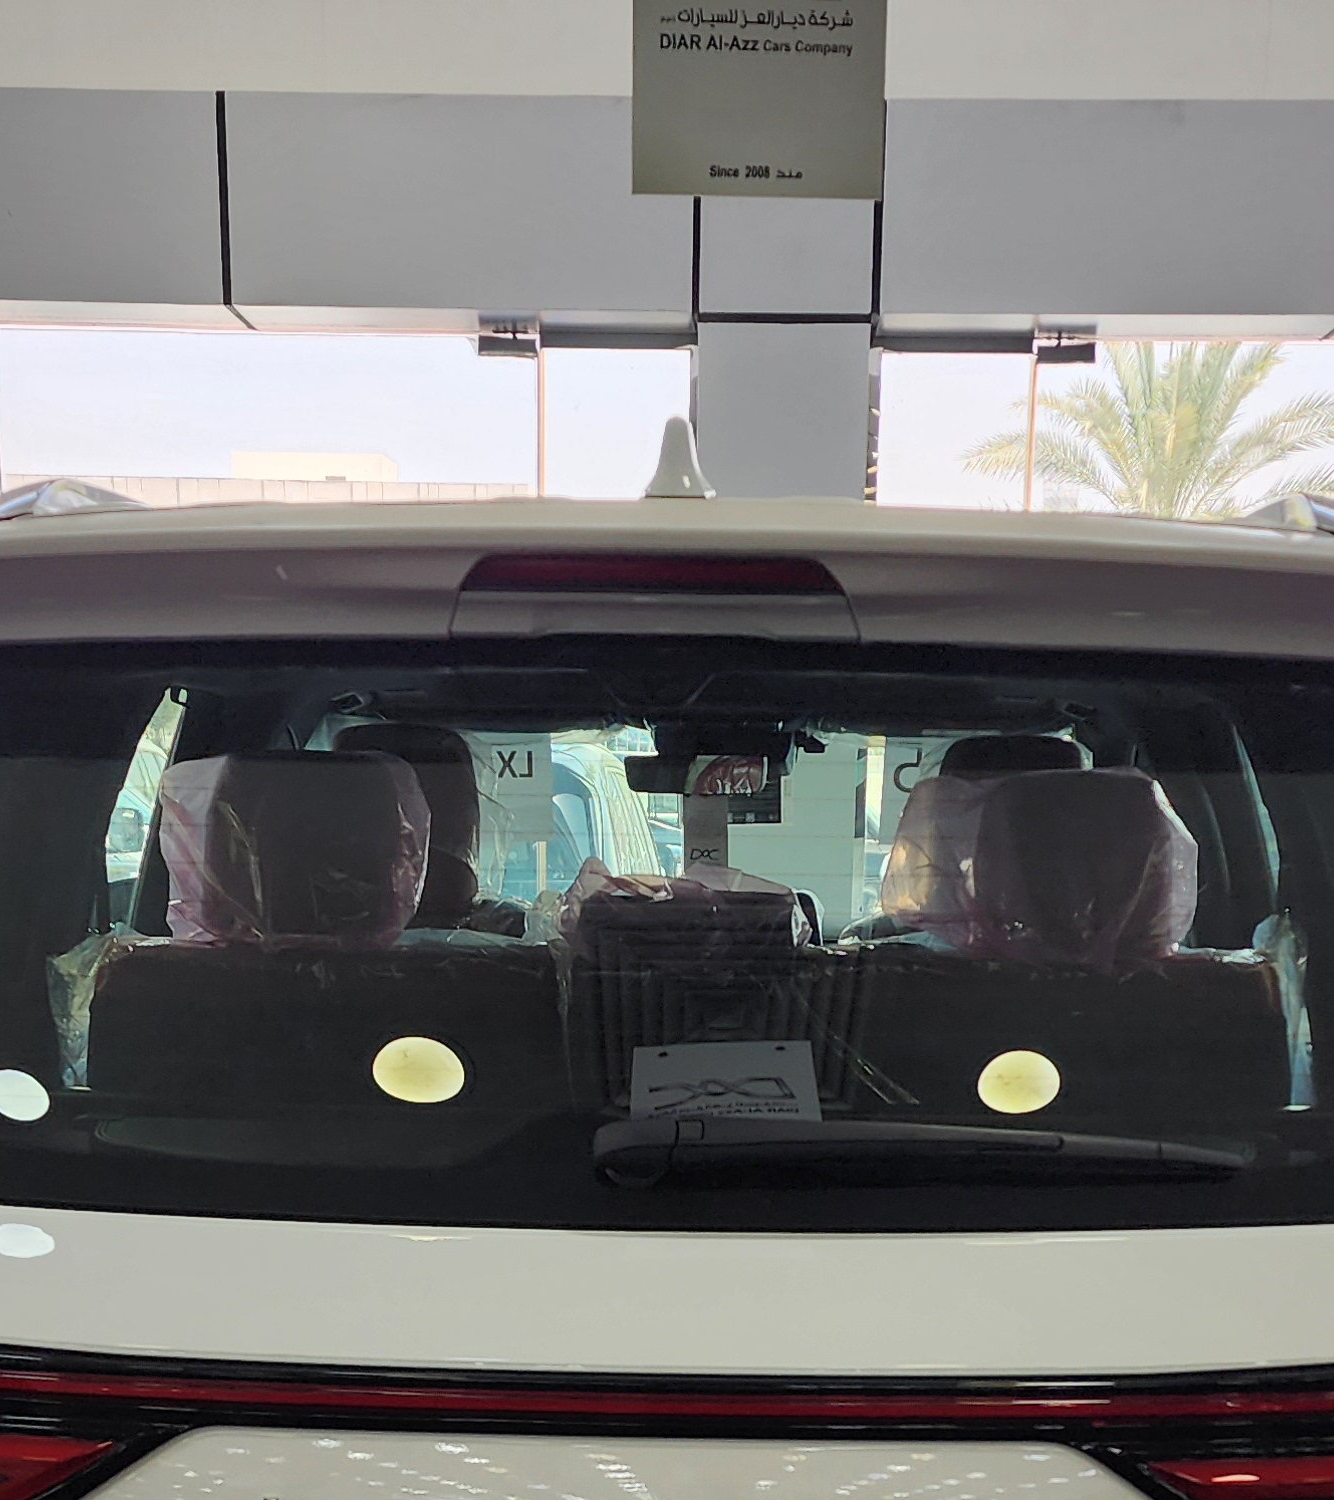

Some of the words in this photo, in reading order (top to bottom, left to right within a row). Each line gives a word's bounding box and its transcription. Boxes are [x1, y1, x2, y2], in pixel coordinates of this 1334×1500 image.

[677, 7, 739, 28] للسيارات
[808, 9, 854, 31] شركة
[659, 33, 702, 50] DIAR
[763, 39, 792, 52] Cars
[795, 40, 854, 57] Company
[709, 164, 739, 178] Since
[745, 165, 771, 179] 2008
